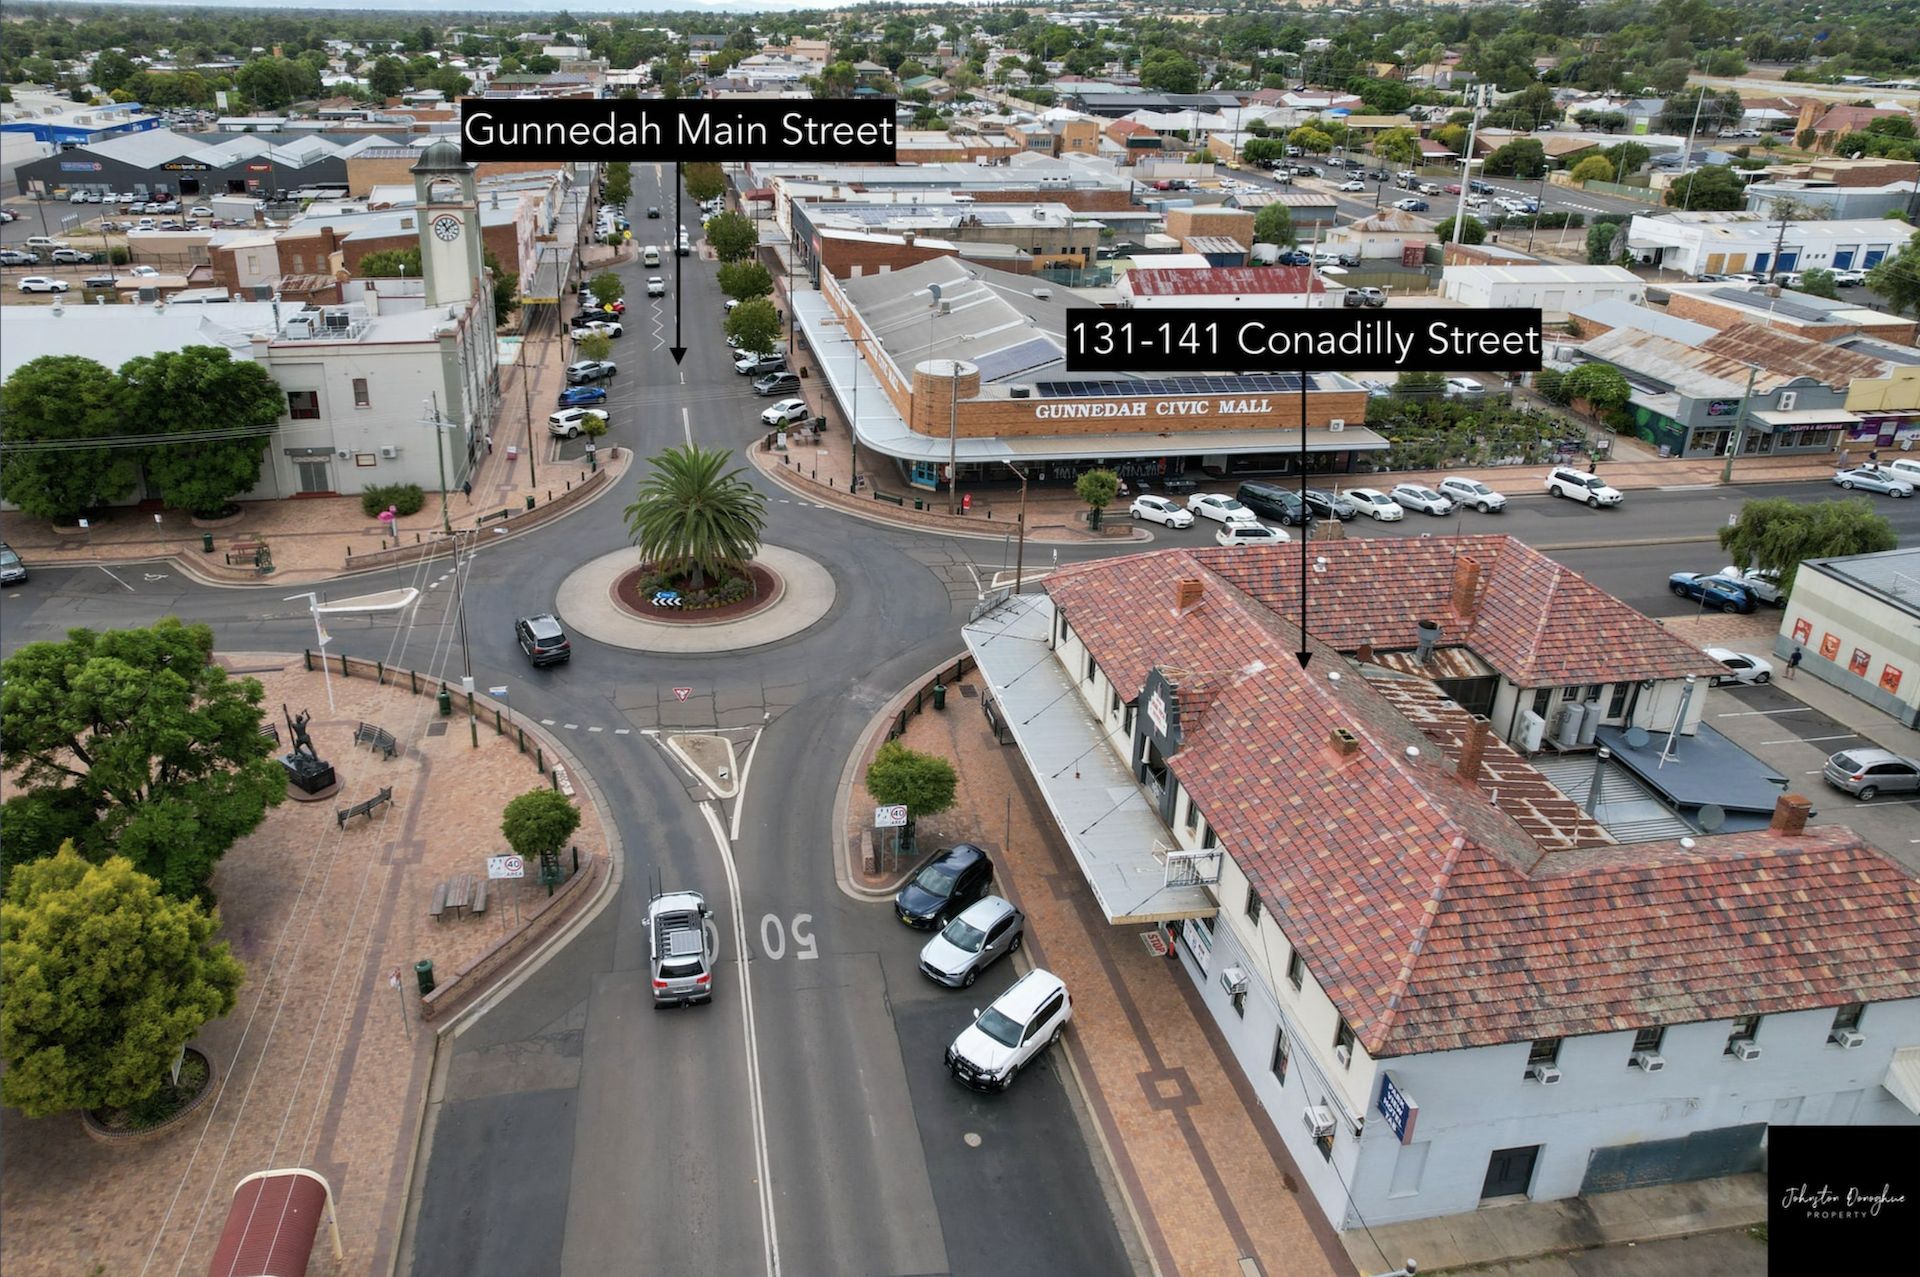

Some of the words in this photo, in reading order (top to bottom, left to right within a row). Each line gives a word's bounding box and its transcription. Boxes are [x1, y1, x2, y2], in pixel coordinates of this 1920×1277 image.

[1035, 402, 1148, 419] GUNNEDAH
[1155, 400, 1210, 416] CIVIC
[1218, 398, 1273, 414] MALL
[893, 809, 905, 817] 40
[507, 860, 520, 868] 40
[760, 912, 820, 961] 50
[1147, 933, 1166, 954] STOP
[1387, 1091, 1404, 1117] VIEW
[1388, 1082, 1405, 1109] PARK
[1383, 1096, 1402, 1128] HOTEL
[1384, 1110, 1397, 1132] TAB
